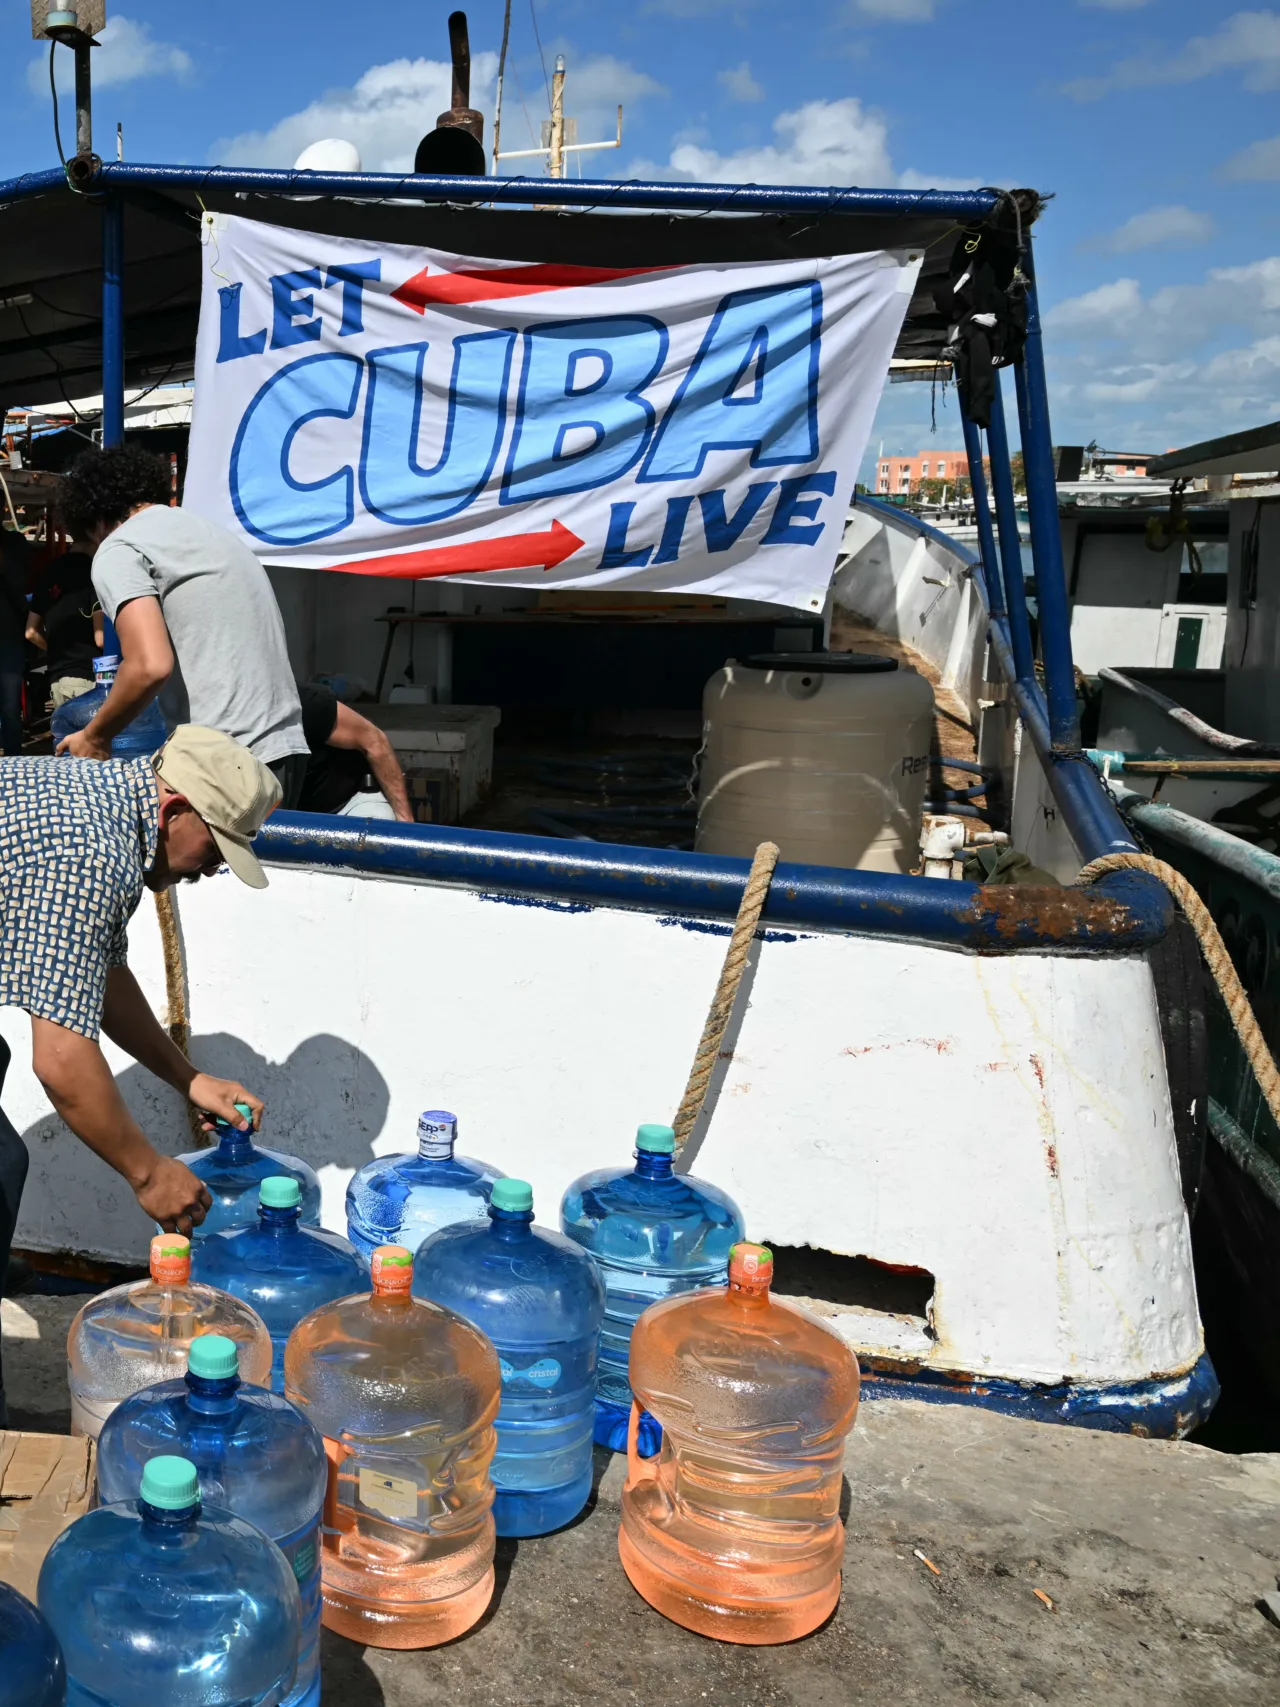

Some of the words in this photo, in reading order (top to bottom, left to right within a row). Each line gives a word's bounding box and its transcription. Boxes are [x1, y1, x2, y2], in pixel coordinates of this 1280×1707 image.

[216, 258, 382, 363] LET
[228, 279, 824, 547] CUBA
[598, 470, 838, 570] LIVE
[528, 1368, 559, 1377] cristal
